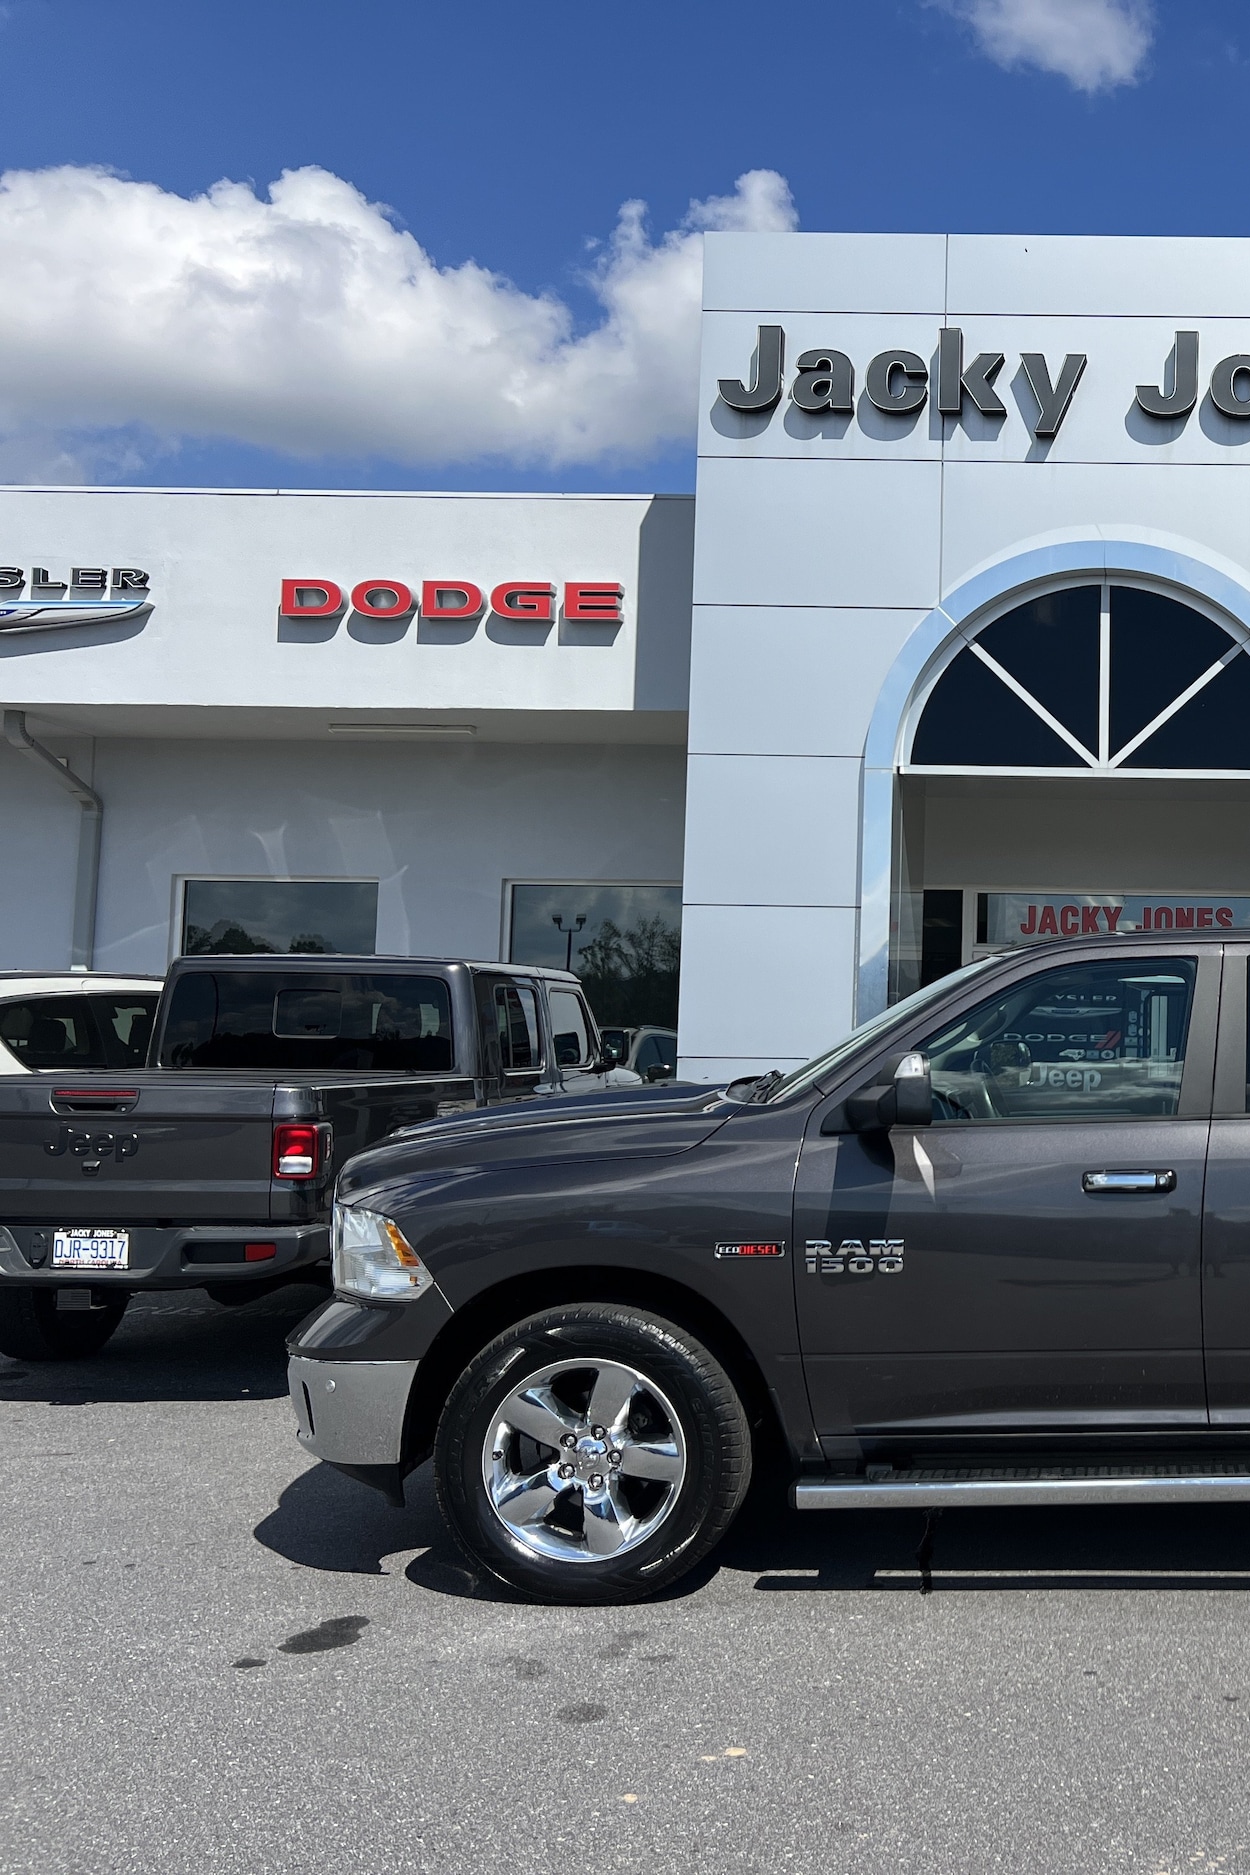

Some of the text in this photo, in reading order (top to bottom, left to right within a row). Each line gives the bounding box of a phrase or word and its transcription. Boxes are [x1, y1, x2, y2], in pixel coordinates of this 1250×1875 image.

[717, 325, 1087, 438] Jacky
[280, 578, 624, 623] DODGE
[1020, 905, 1233, 935] JACKY JONES
[1055, 994, 1117, 1002] YSLER
[1003, 1033, 1108, 1042] DODGE
[1031, 1062, 1102, 1092] Jeep
[43, 1122, 139, 1162] Jeep
[70, 1229, 114, 1238] JACKY JONES
[54, 1239, 126, 1259] DJR-9317
[718, 1245, 779, 1255] ECODIESEL
[805, 1239, 904, 1256] RAM
[805, 1257, 904, 1274] 1500
